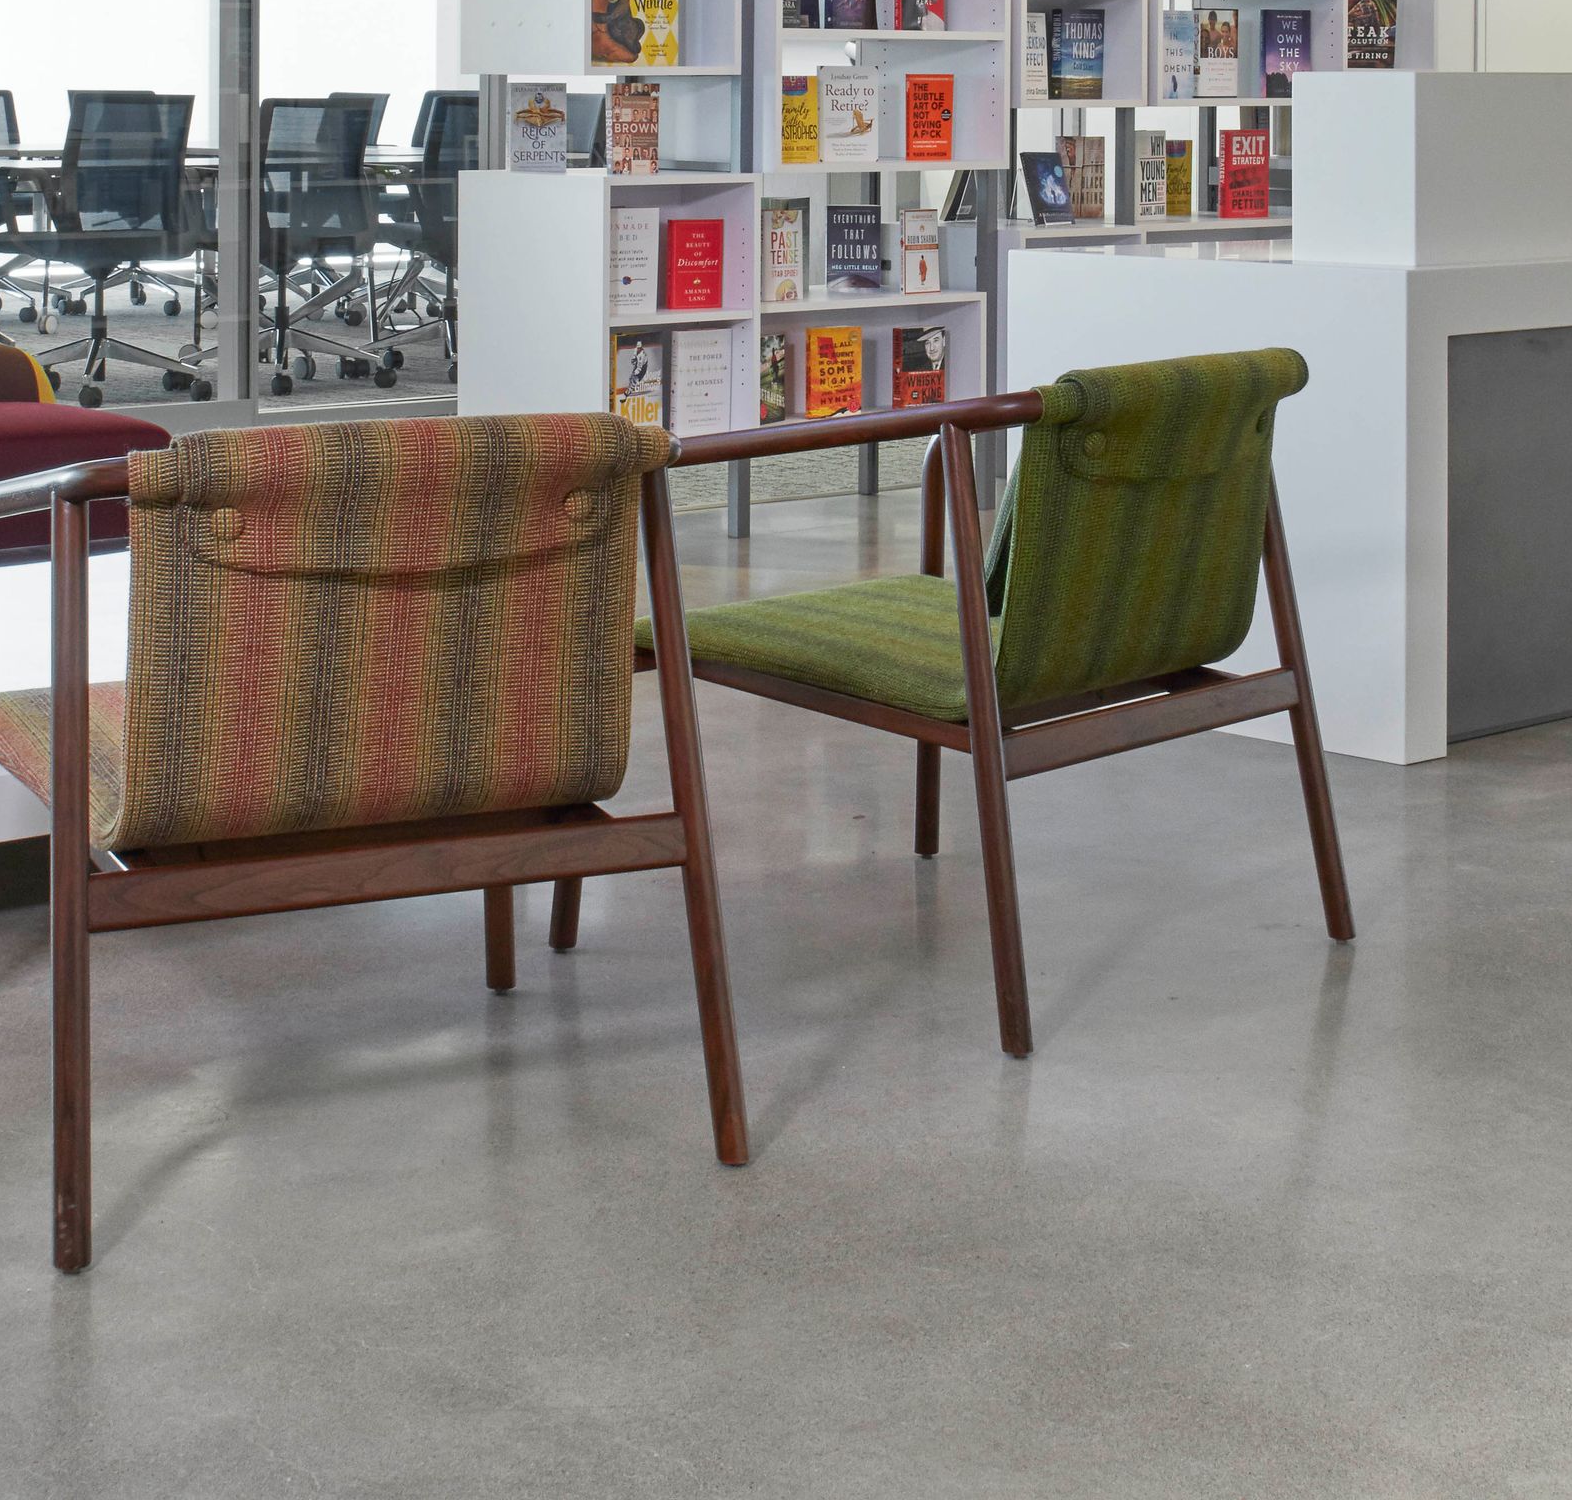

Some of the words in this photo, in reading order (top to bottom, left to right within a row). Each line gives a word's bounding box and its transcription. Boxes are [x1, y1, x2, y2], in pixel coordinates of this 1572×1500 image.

[1064, 22, 1104, 41] THOMAS
[1281, 20, 1298, 31] WE
[1276, 33, 1303, 44] OWN
[1072, 41, 1096, 60] KING
[1165, 48, 1184, 58] THIS
[1207, 46, 1235, 59] BOYS
[1279, 47, 1301, 58] THE
[1355, 52, 1389, 60] FIRING
[1279, 61, 1300, 72] SKY
[825, 83, 861, 100] Ready
[863, 85, 875, 97] to
[912, 83, 929, 92] THE
[912, 92, 945, 101] SUBTLE
[831, 99, 869, 112] Retire?
[912, 102, 929, 110] ART
[931, 101, 944, 110] OF
[912, 111, 930, 120] NOT
[614, 122, 659, 134] BROWN
[912, 120, 942, 130] GIVING
[521, 125, 557, 140] REIGN
[605, 109, 613, 158] BROWN
[532, 139, 546, 150] OF
[1150, 135, 1166, 157] WHY
[1232, 136, 1266, 156] EXIT
[513, 150, 566, 164] SERPENTS
[1232, 156, 1266, 166] STRATEGY
[1139, 160, 1166, 181] YOUNG
[1140, 182, 1158, 203] MEN
[833, 213, 876, 225] EVERYTHING
[770, 230, 799, 250] PAST
[843, 229, 865, 240] THAT
[770, 250, 799, 265] TENSE
[831, 244, 878, 261] FOLLOWS
[677, 258, 719, 269] Discomfort
[819, 365, 854, 377] SOME
[907, 373, 942, 388] WHISKY
[922, 387, 942, 403] KING
[619, 396, 661, 424] Killer
